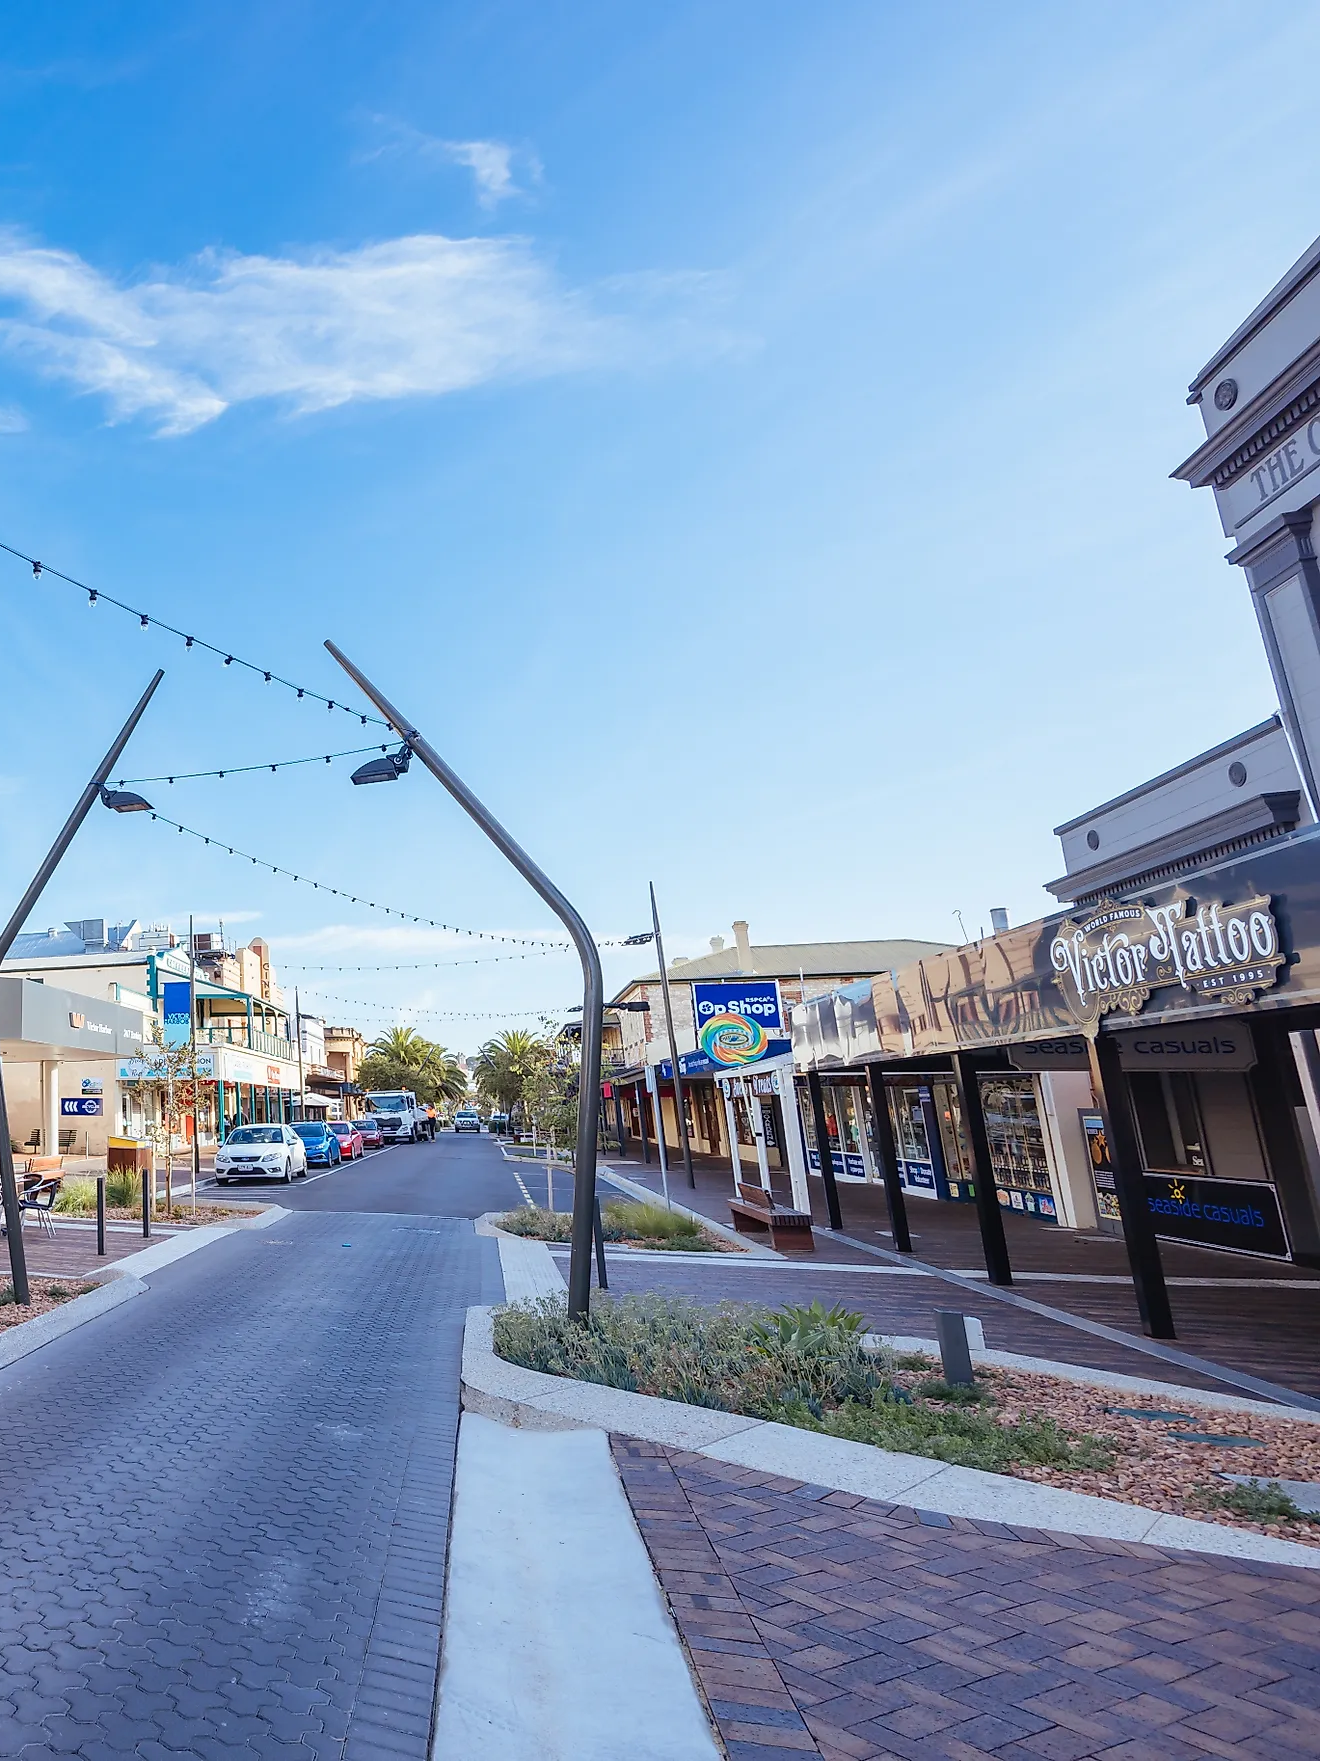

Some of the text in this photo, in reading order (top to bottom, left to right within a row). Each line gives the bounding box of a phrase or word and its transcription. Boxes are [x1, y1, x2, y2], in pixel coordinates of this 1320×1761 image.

[1250, 438, 1305, 501] THE
[1083, 908, 1141, 933] WORLD FAMOUS
[1049, 899, 1274, 1007] Victor Tattoo
[1202, 969, 1264, 989] EST 1995
[727, 1000, 776, 1016] Shop
[1134, 1036, 1237, 1055] casuals
[1147, 1197, 1265, 1228] seaside casuals
